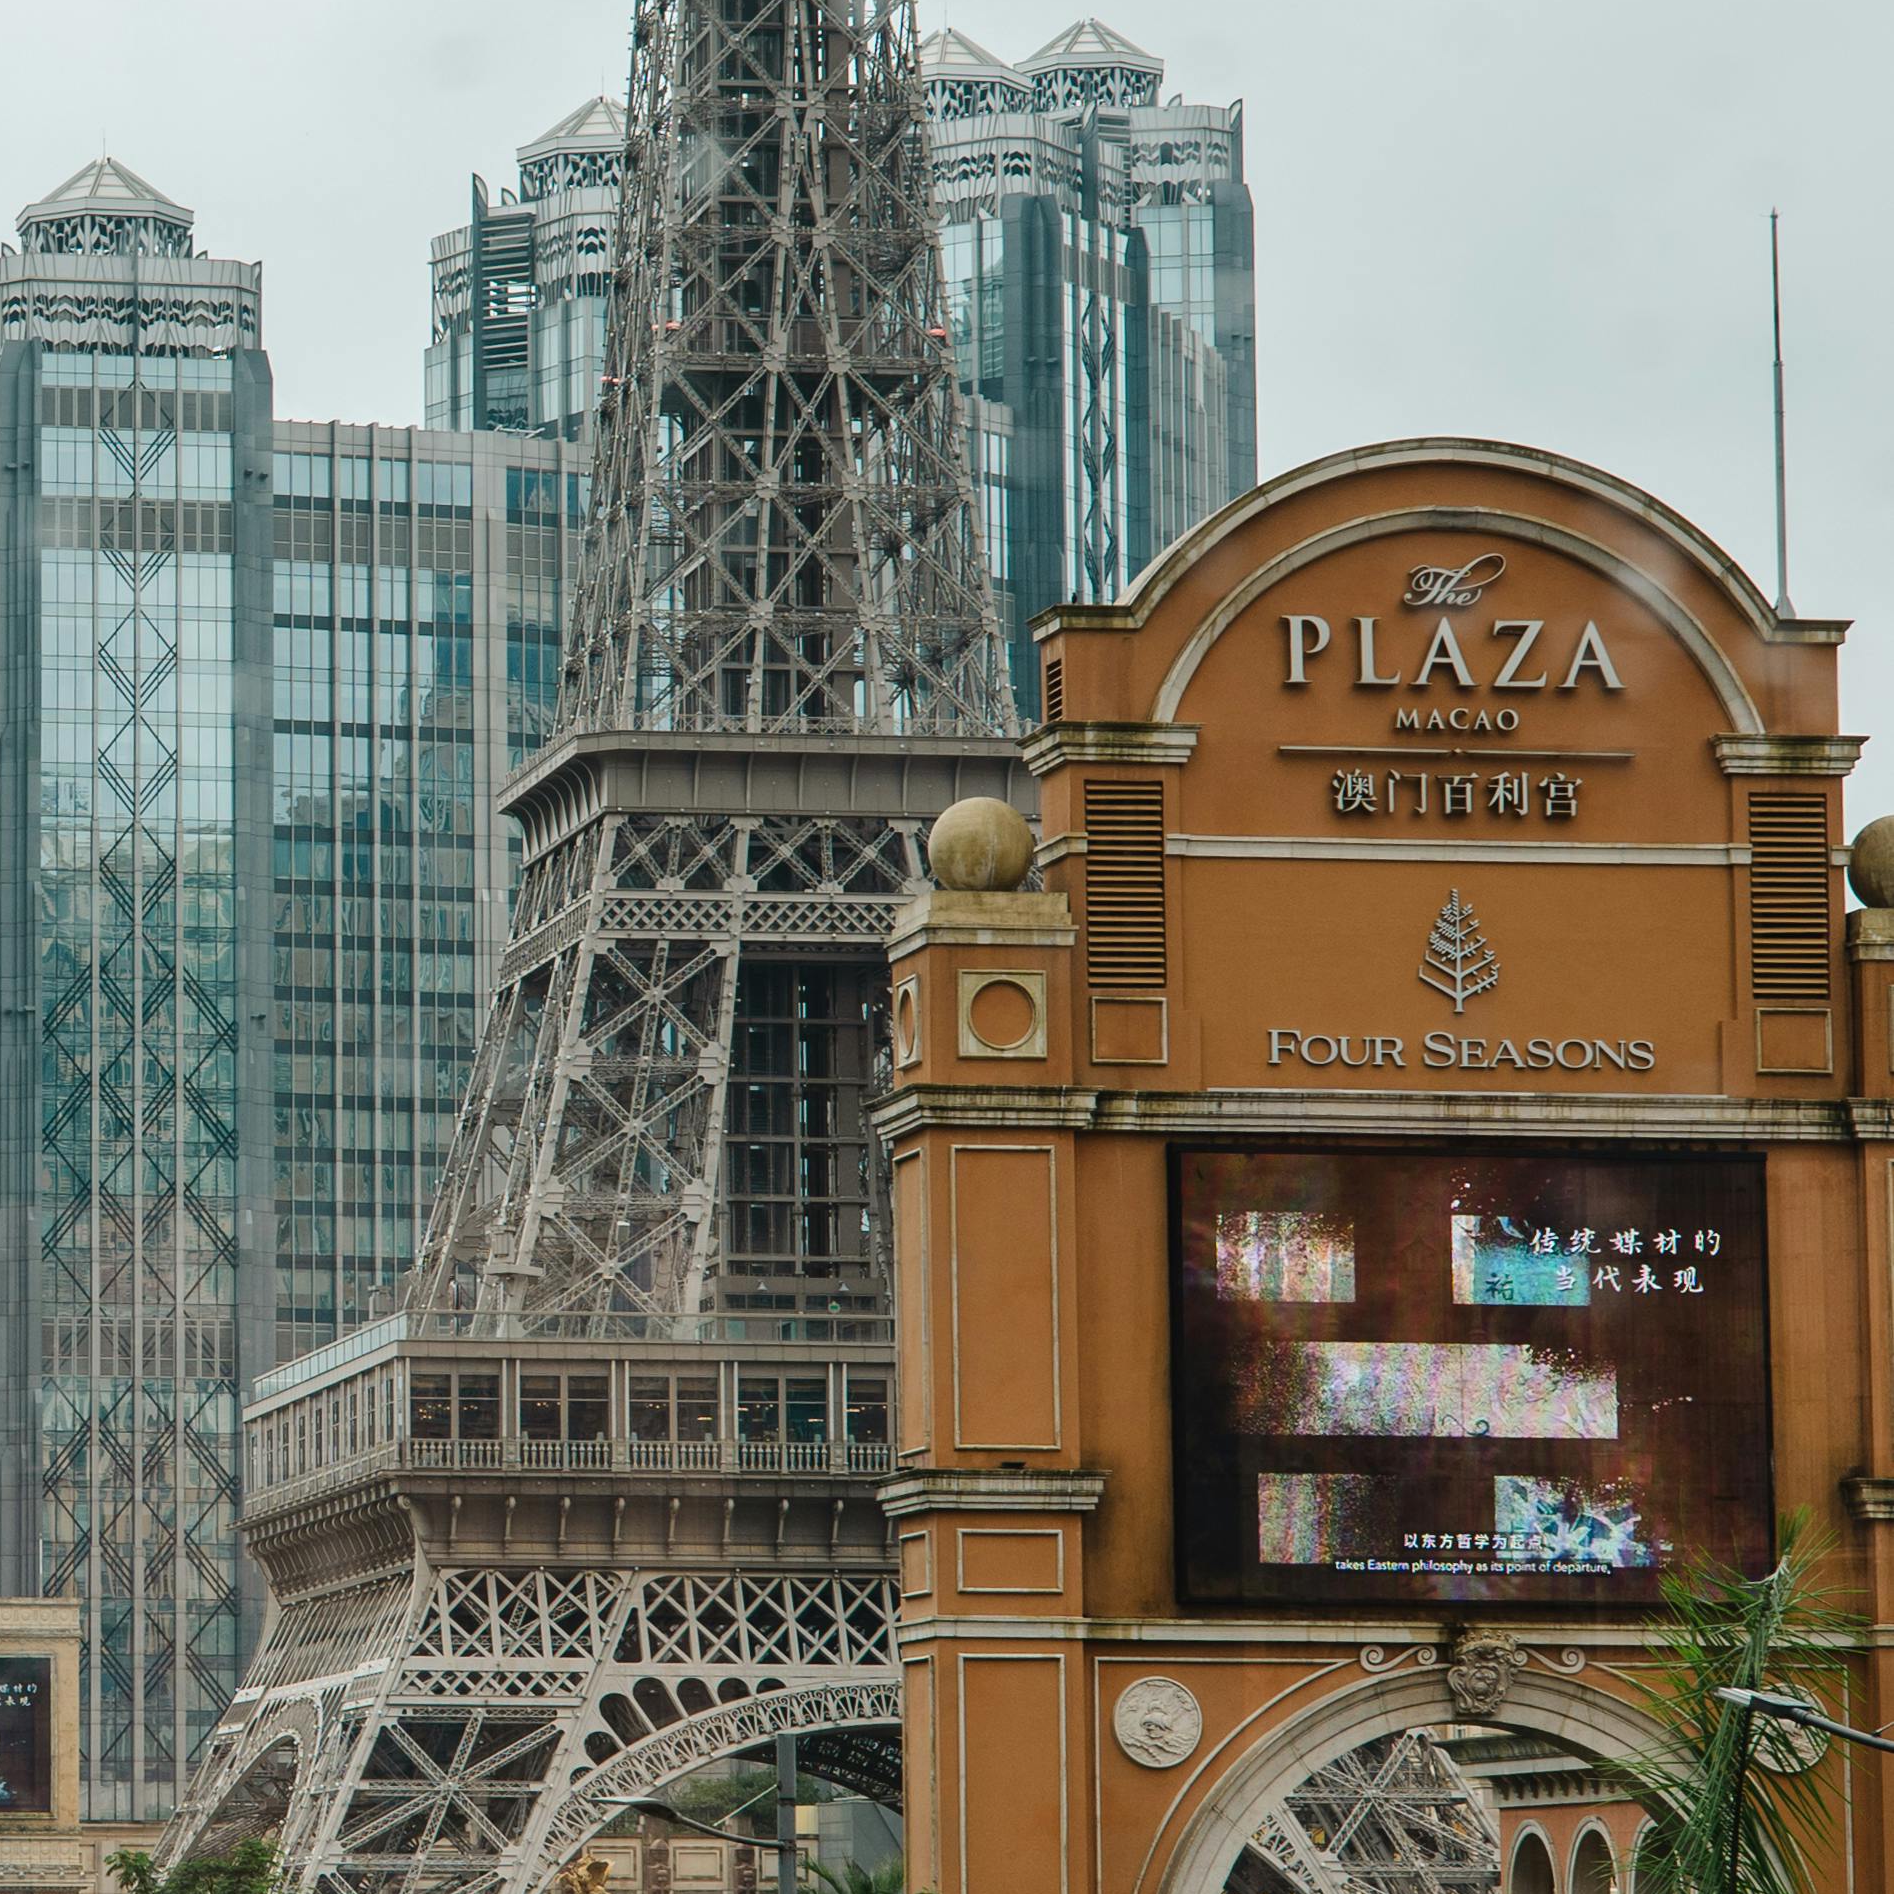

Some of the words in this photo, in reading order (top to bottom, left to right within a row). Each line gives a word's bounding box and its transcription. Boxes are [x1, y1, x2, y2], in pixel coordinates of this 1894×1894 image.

[1403, 553, 1506, 606] The
[1280, 614, 1627, 689] PLAZA
[1395, 707, 1520, 732] MACAO
[1331, 767, 1583, 817] 澳门百利宫
[1267, 1029, 1406, 1067] FOUR
[1423, 1031, 1656, 1070] SEASONS
[1529, 1227, 1721, 1256] 传统媒材的
[1555, 1264, 1705, 1294] 当代表现
[1335, 1559, 1366, 1571] takes
[1367, 1559, 1410, 1571] Eastern
[1411, 1559, 1473, 1575] philosophy
[1475, 1562, 1488, 1572] as
[1490, 1561, 1504, 1572] its
[1506, 1561, 1536, 1574] point
[1538, 1561, 1551, 1572] of
